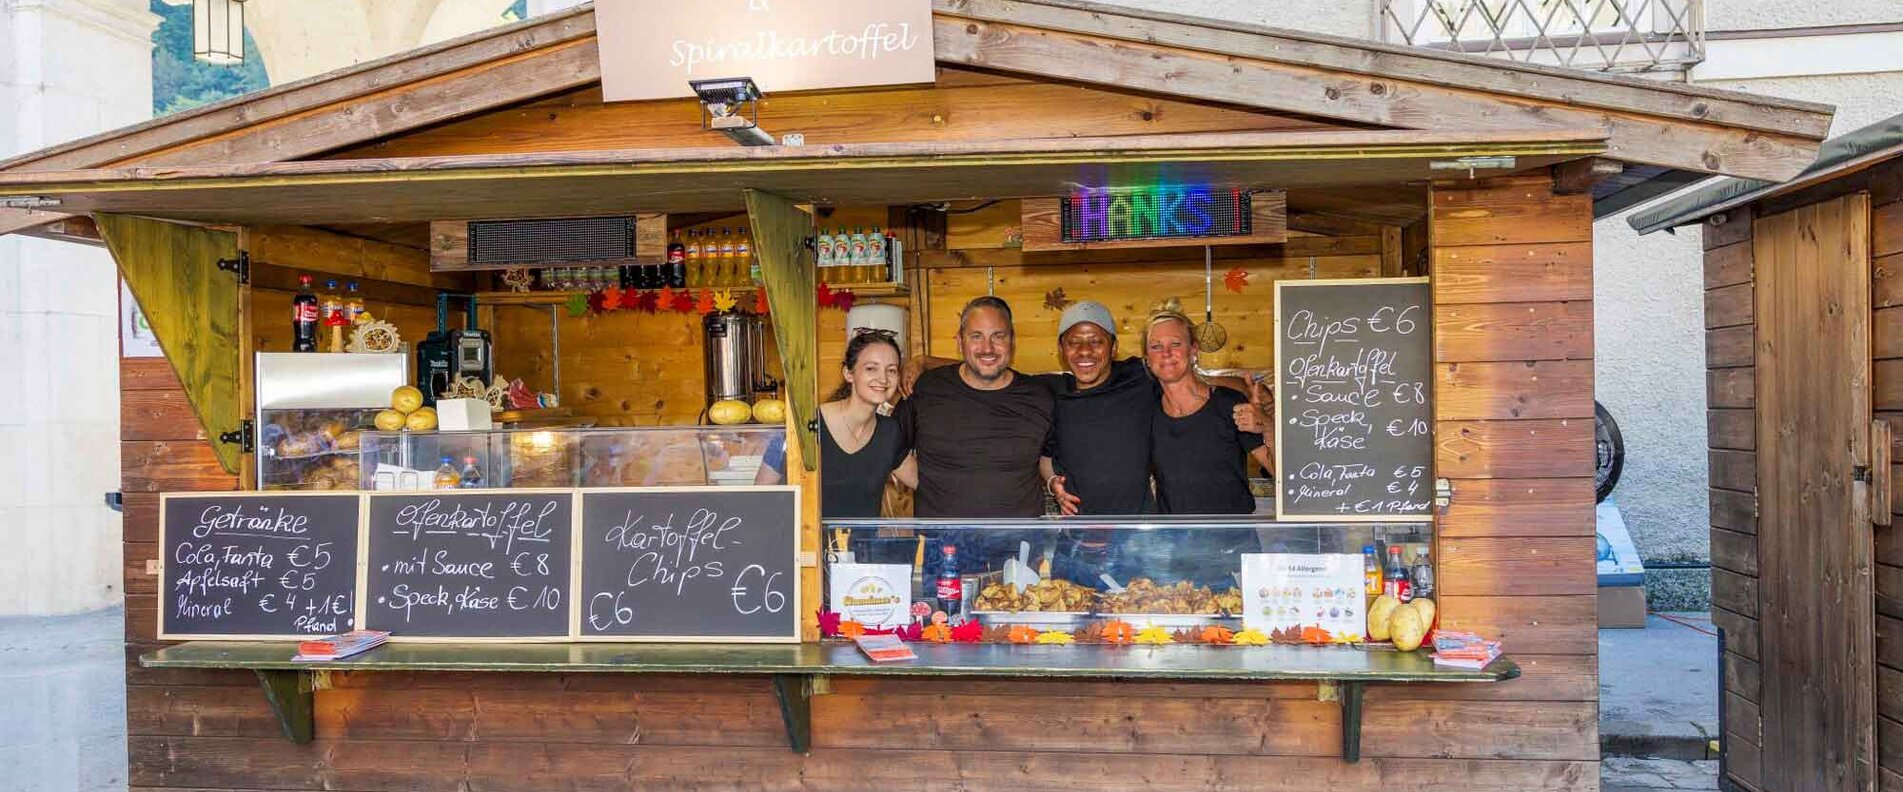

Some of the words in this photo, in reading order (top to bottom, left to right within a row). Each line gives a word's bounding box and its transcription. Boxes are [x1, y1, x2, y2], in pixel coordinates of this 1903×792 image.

[669, 22, 918, 73] Spiralkartoffel
[1287, 309, 1361, 359] Chips
[1288, 348, 1397, 395] Ofenkartoffel
[1305, 384, 1381, 407] Sauce
[1300, 409, 1373, 438] Speck,
[1314, 426, 1366, 450] Käse
[193, 505, 308, 539] Getränke
[1385, 499, 1431, 514] Pfand
[396, 498, 557, 555] Ofenkartoffel
[604, 507, 743, 568] Kartoffel-
[175, 567, 266, 596] Apfelsaft
[393, 547, 428, 576] mit
[432, 549, 496, 580] Sauce
[627, 551, 724, 596] Chips
[175, 593, 233, 619] Mineral
[389, 583, 454, 623] Speck,
[455, 584, 499, 611] Käse
[730, 564, 786, 615] €6
[294, 614, 337, 633] Pfand
[588, 591, 633, 631] €6
